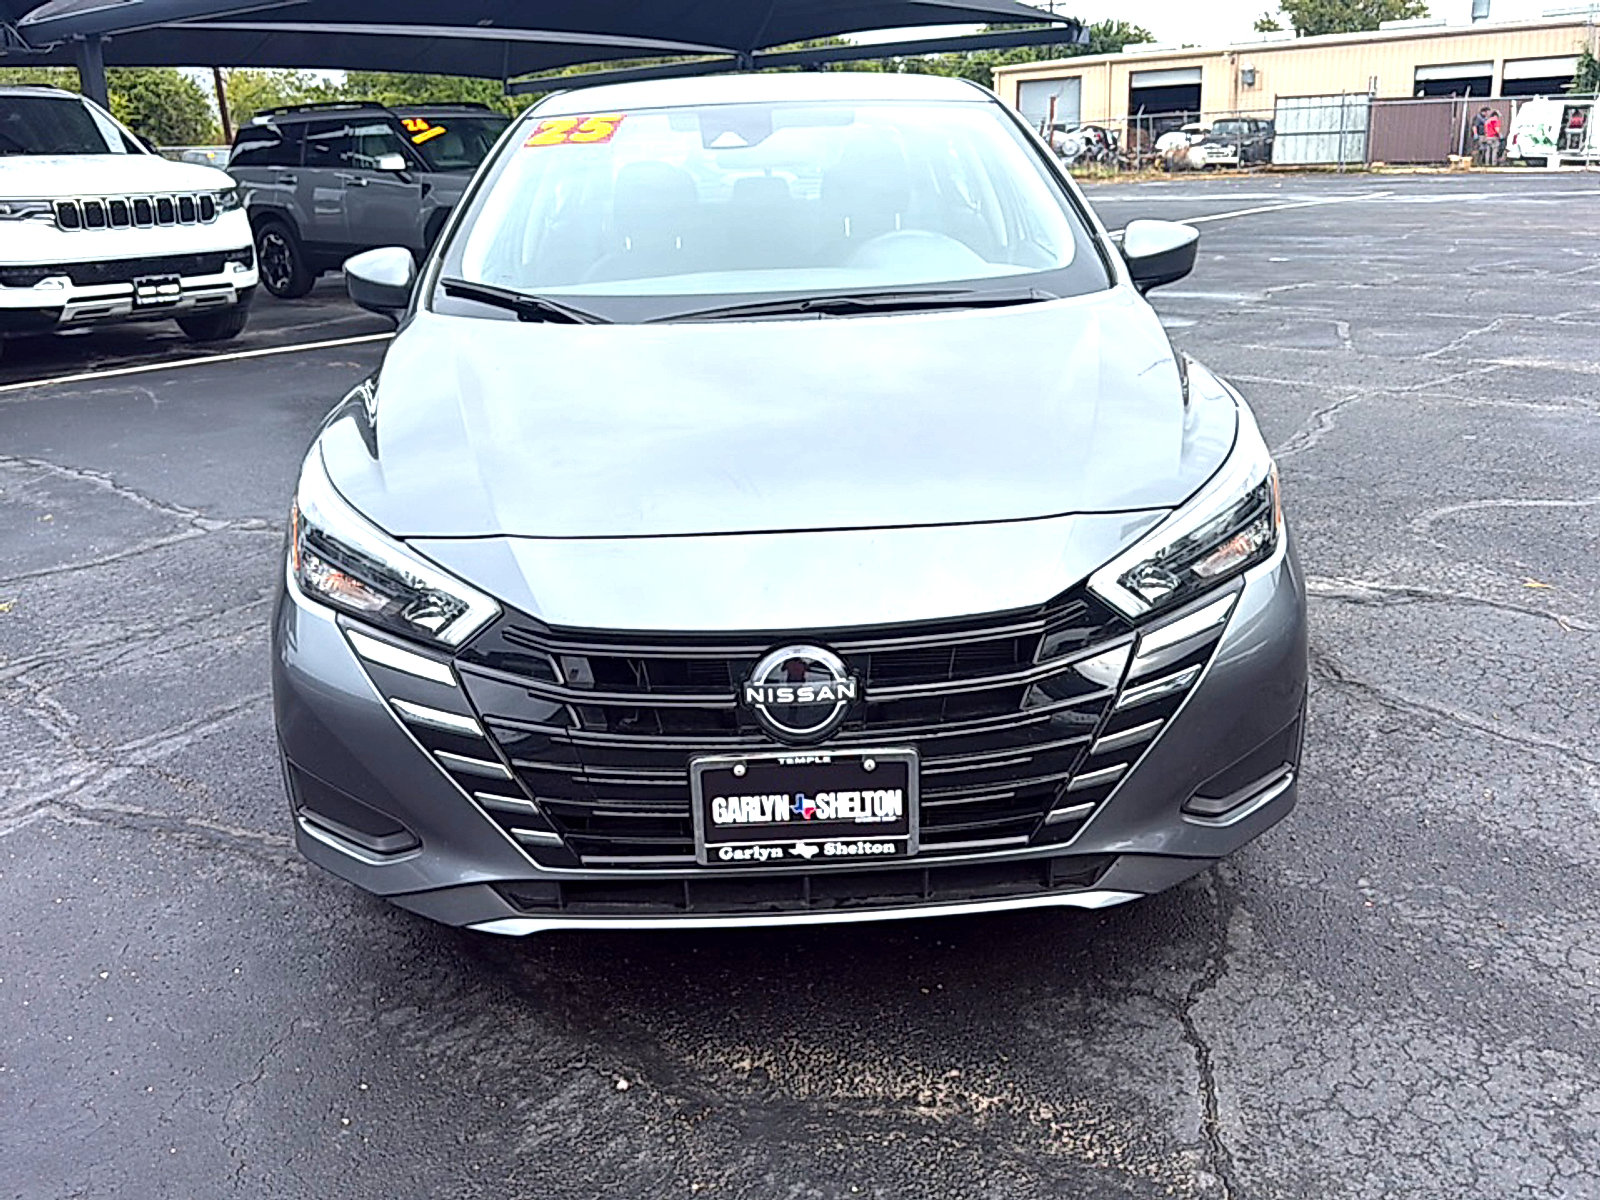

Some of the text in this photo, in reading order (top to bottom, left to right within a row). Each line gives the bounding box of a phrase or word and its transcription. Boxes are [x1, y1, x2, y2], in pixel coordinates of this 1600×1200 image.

[525, 114, 624, 147] 25
[746, 683, 855, 703] NISSAN
[777, 756, 832, 765] TEMPLE
[712, 789, 903, 824] GARLYN SHELTON
[718, 841, 896, 862] Garlyn Shelton
